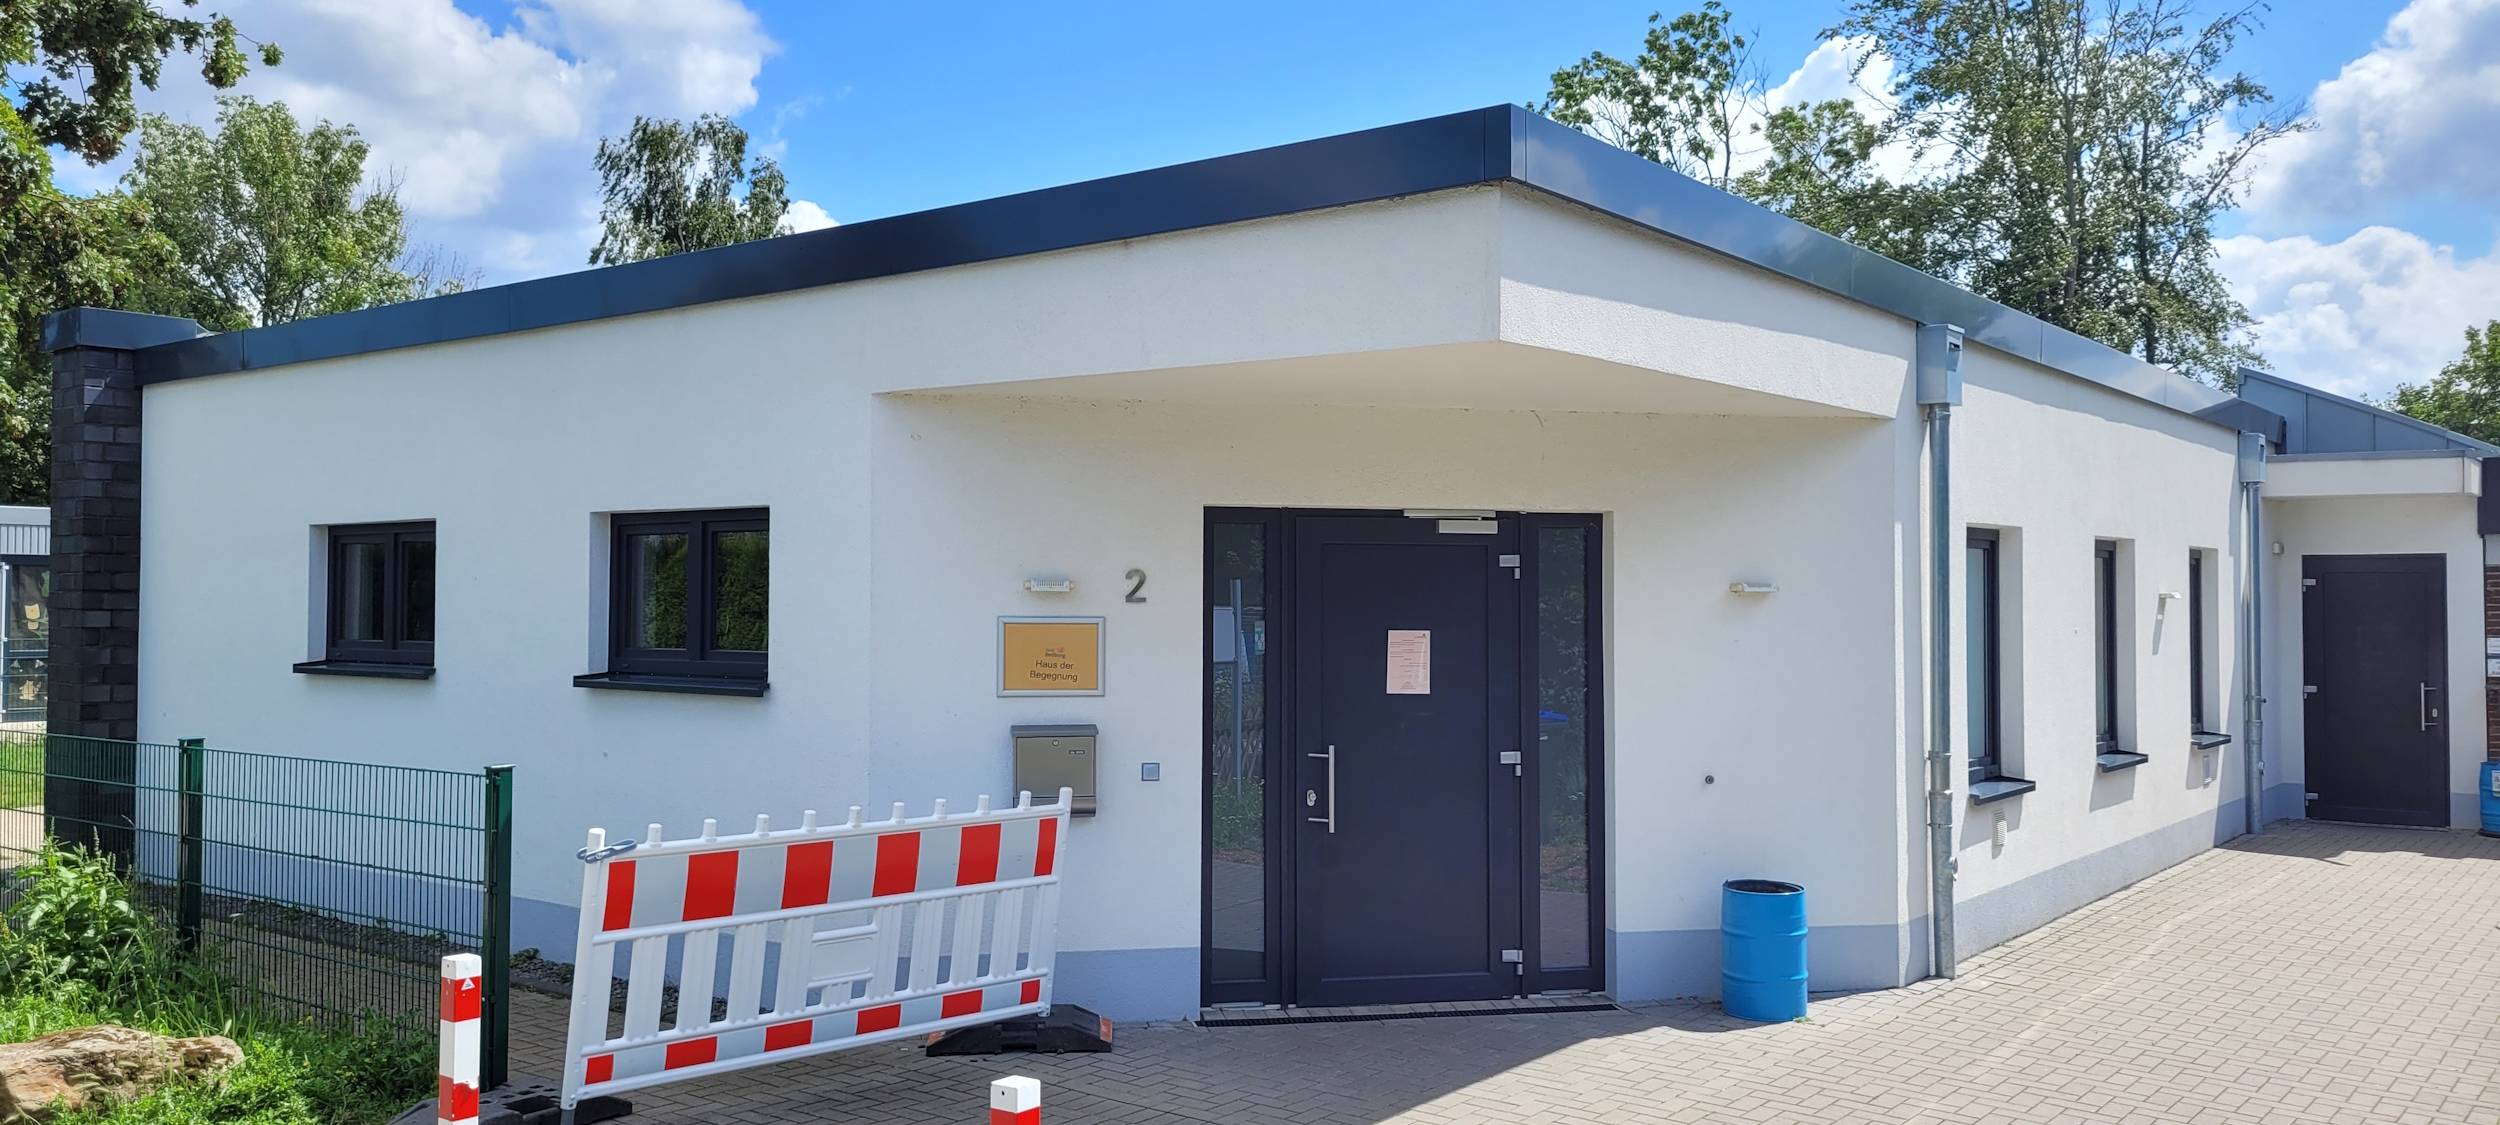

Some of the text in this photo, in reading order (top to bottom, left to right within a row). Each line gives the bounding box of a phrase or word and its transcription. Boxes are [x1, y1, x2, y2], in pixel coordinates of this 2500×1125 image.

[1125, 568, 1146, 603] 2
[1035, 660, 1074, 670] Haus der
[1029, 670, 1078, 682] Begegnung
